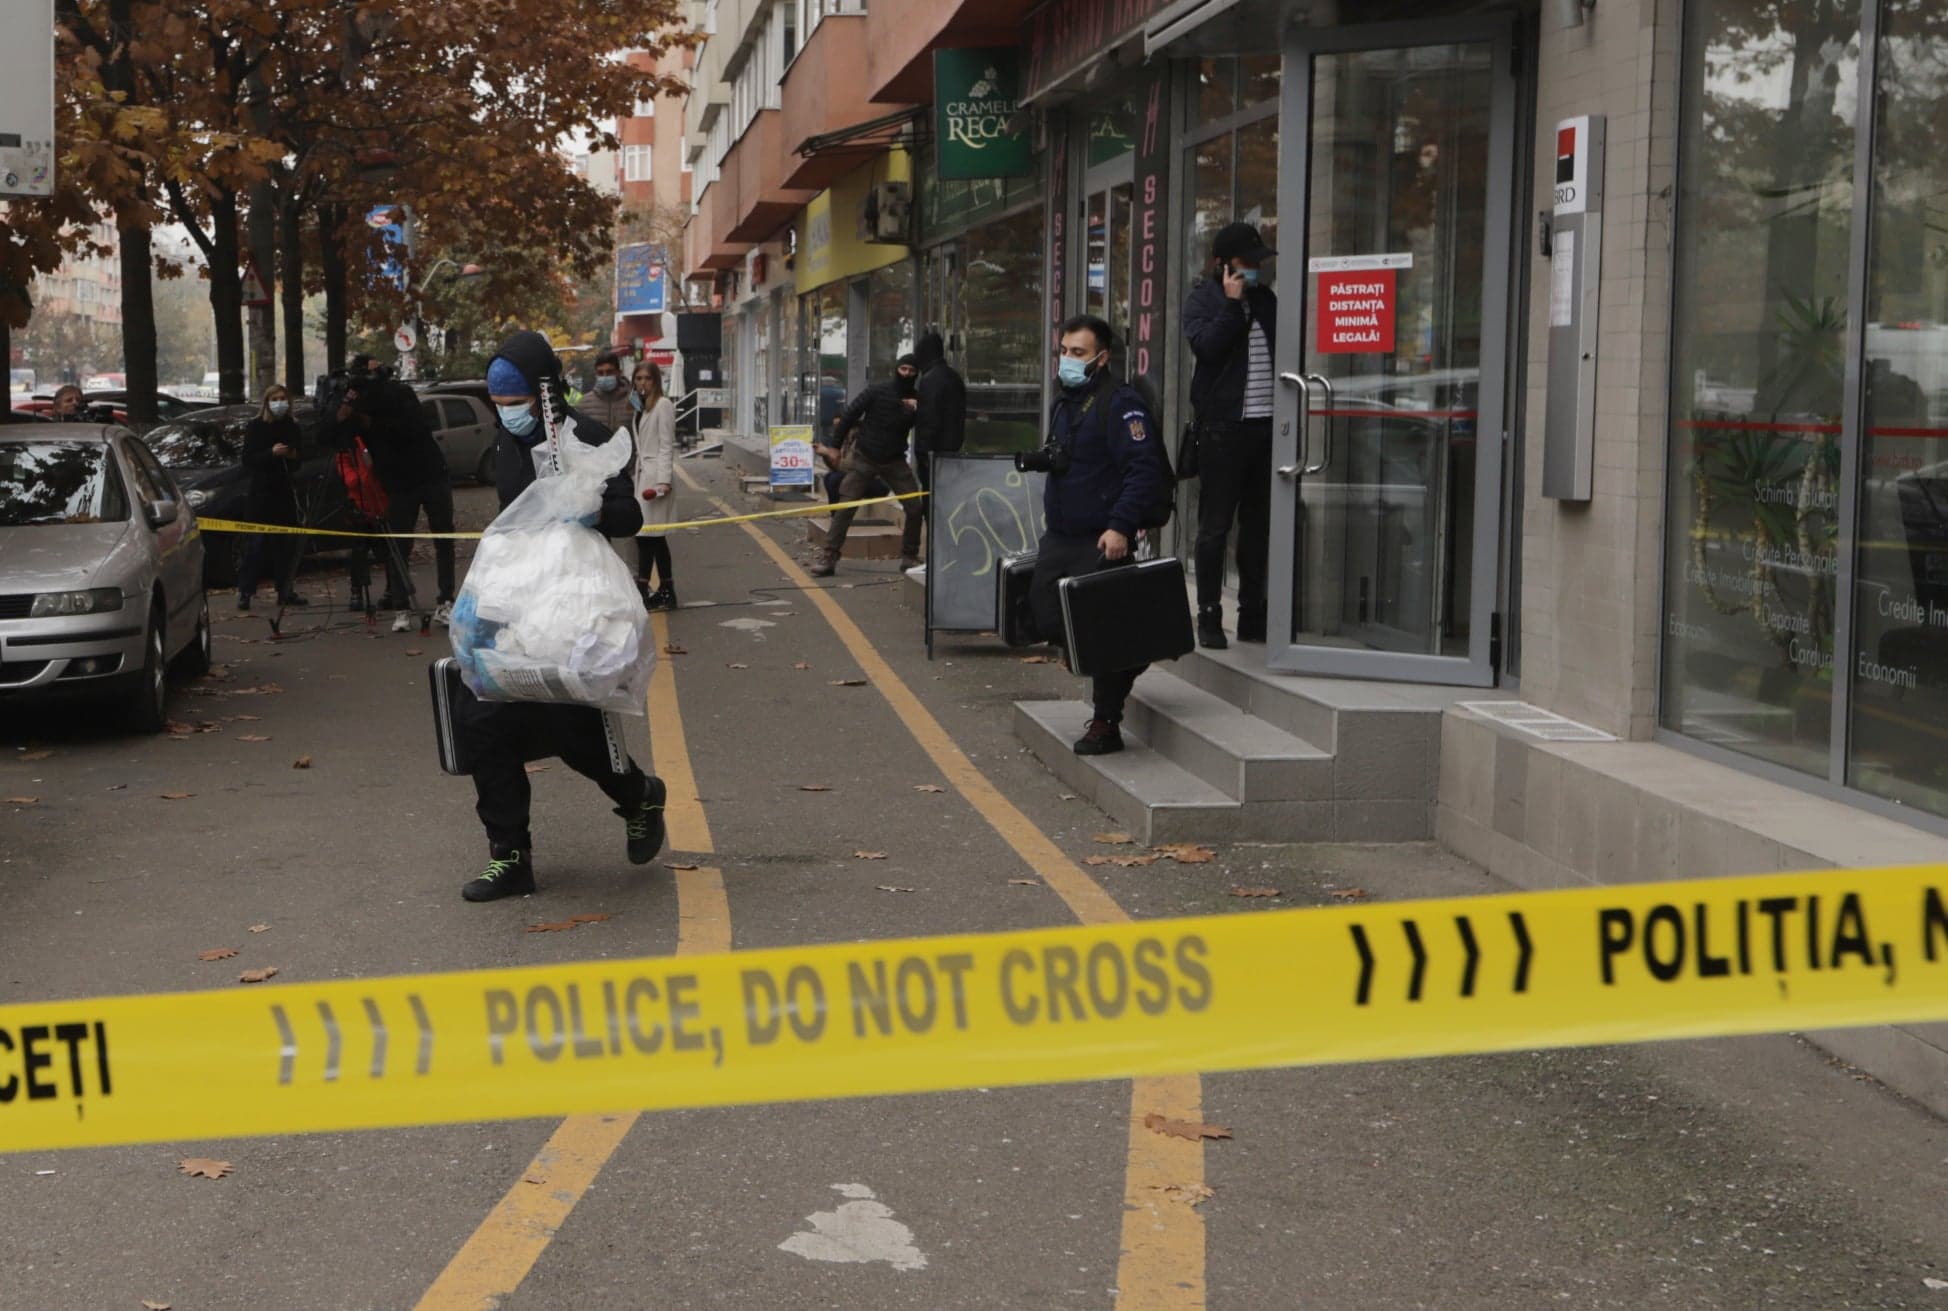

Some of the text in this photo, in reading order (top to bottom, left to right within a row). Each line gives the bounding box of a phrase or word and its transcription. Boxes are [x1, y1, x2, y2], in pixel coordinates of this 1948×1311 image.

[946, 116, 1020, 148] RECA
[1553, 186, 1576, 205] BRD
[1138, 175, 1156, 375] SECOND
[1329, 282, 1385, 297] PĂSTRAȚI
[1332, 329, 1381, 343] LEGALĂ!
[1335, 314, 1379, 327] MINIMĂ
[1754, 478, 1793, 505] Schimb
[1761, 602, 1809, 634] Depozite
[1878, 589, 1948, 628] Credite Im
[1858, 650, 1917, 689] Economii
[1598, 892, 1896, 1000] POLIȚIA,
[484, 935, 1214, 1068] POLICE, DO NOT CROSS
